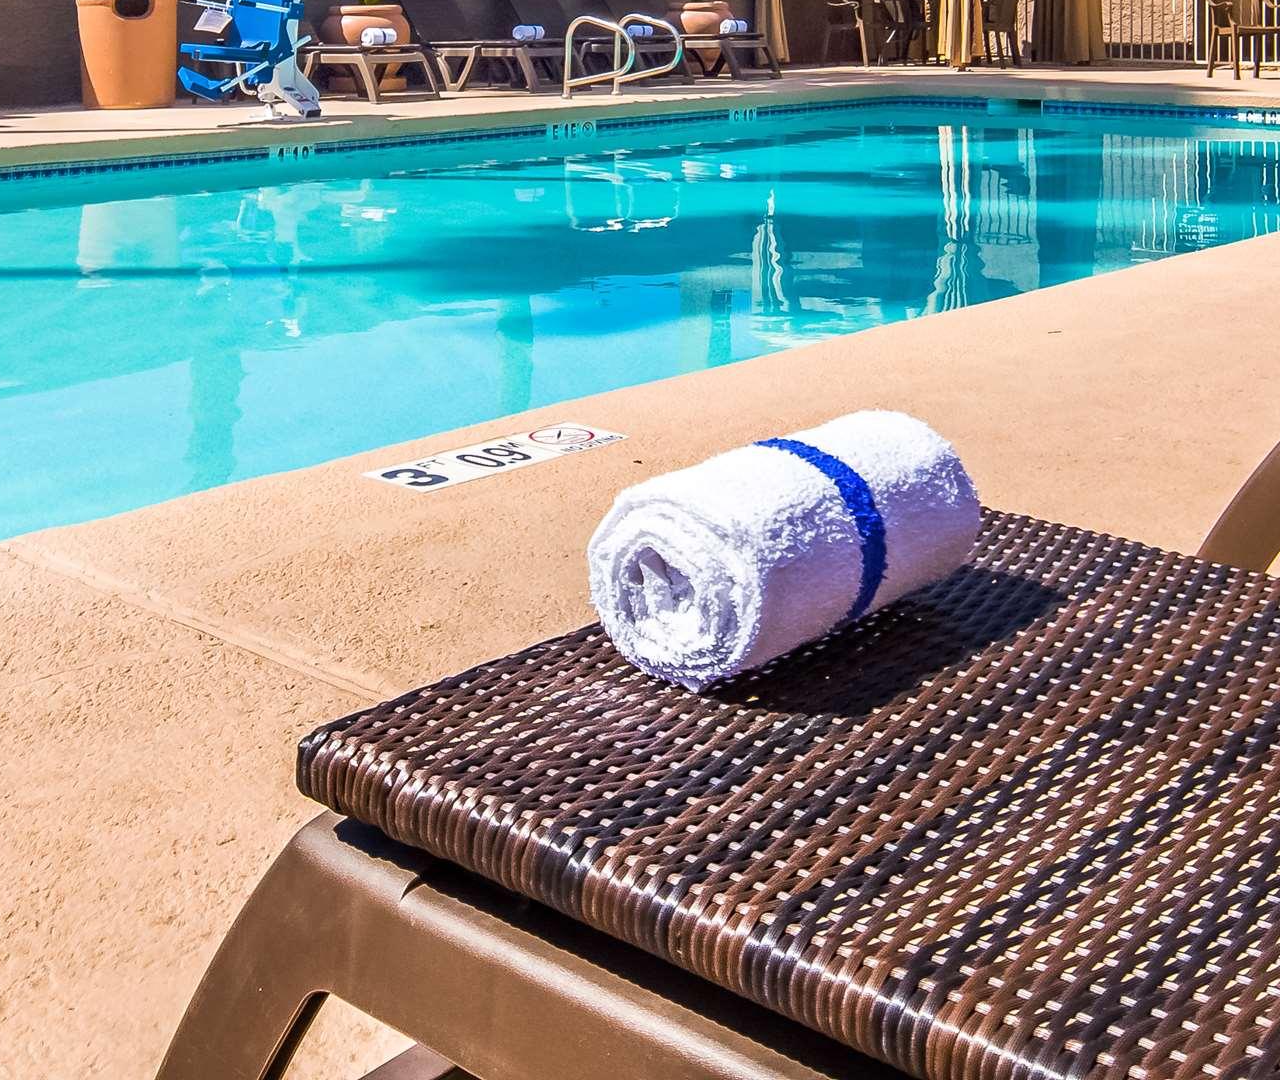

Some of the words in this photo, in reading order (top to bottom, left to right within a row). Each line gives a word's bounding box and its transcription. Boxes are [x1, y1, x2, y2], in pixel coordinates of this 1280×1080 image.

[381, 468, 449, 486] 3
[416, 459, 445, 469] FT
[455, 447, 532, 467] 0.9
